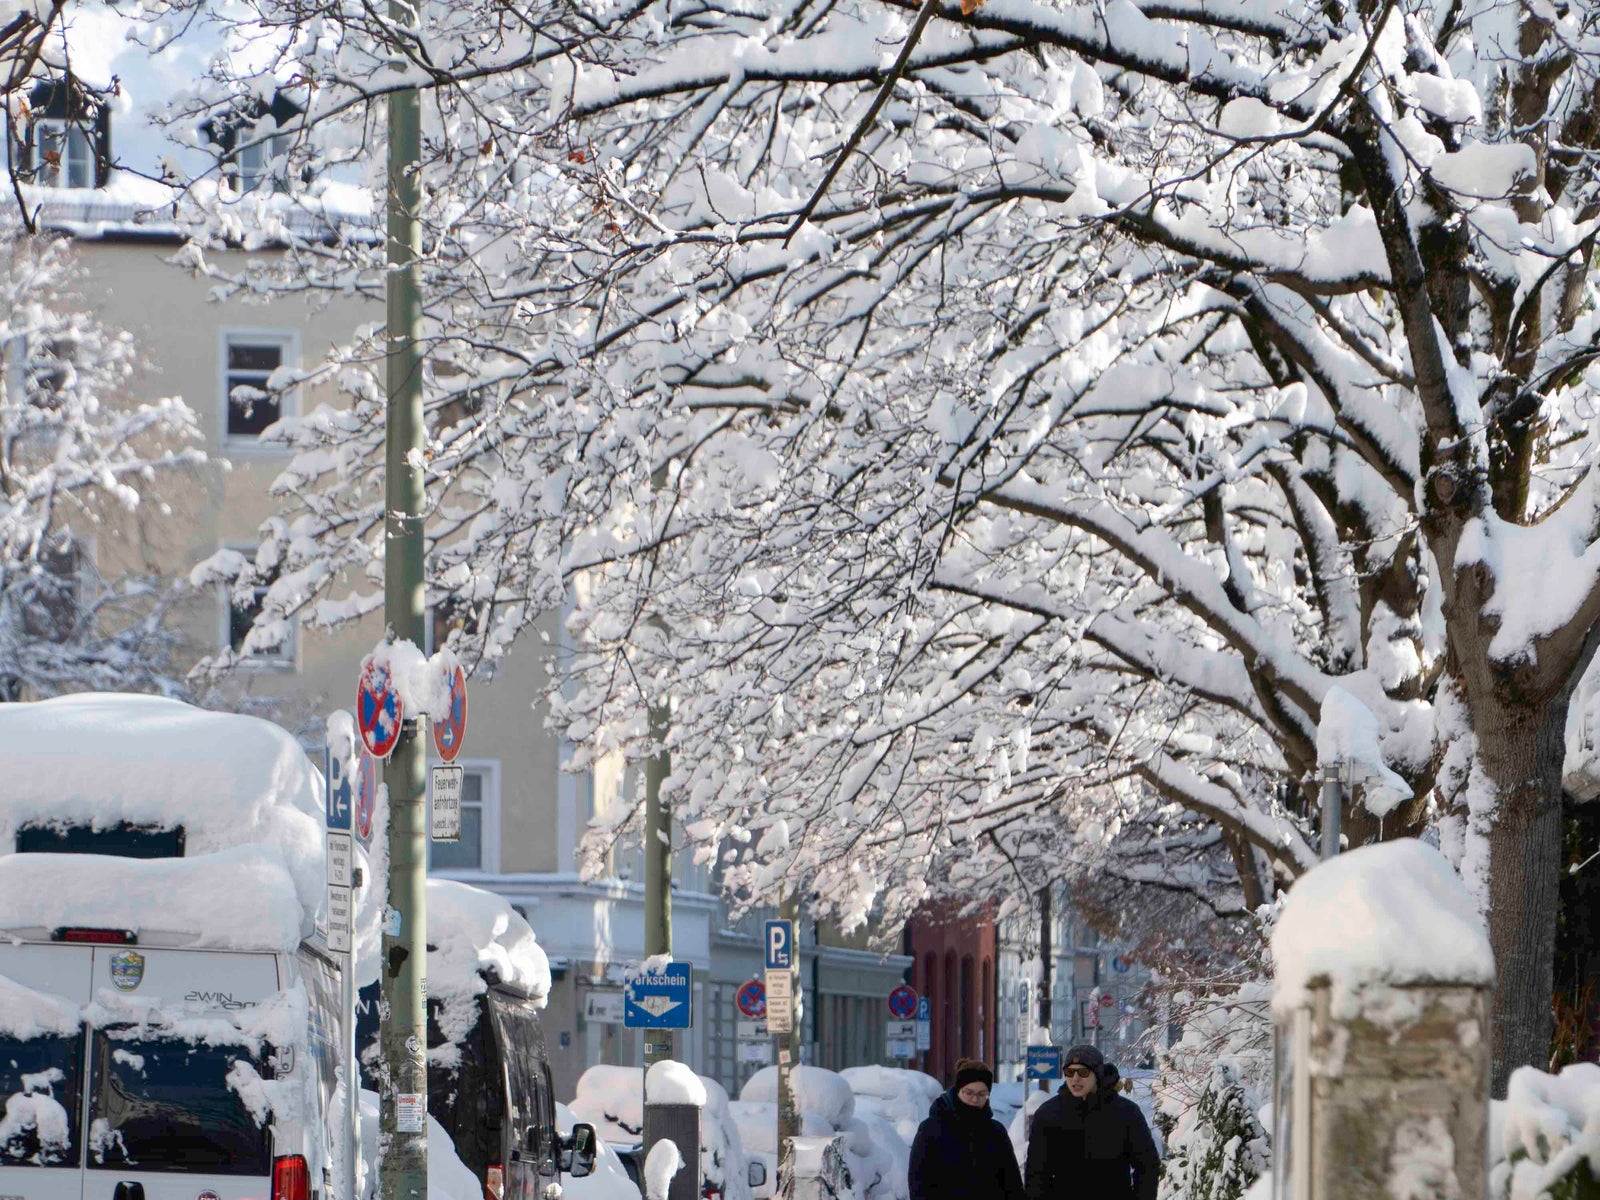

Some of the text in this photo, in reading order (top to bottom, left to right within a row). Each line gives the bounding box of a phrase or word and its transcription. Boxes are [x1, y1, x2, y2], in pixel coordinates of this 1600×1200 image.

[330, 752, 345, 817] P
[770, 926, 785, 964] P
[920, 1001, 928, 1019] P
